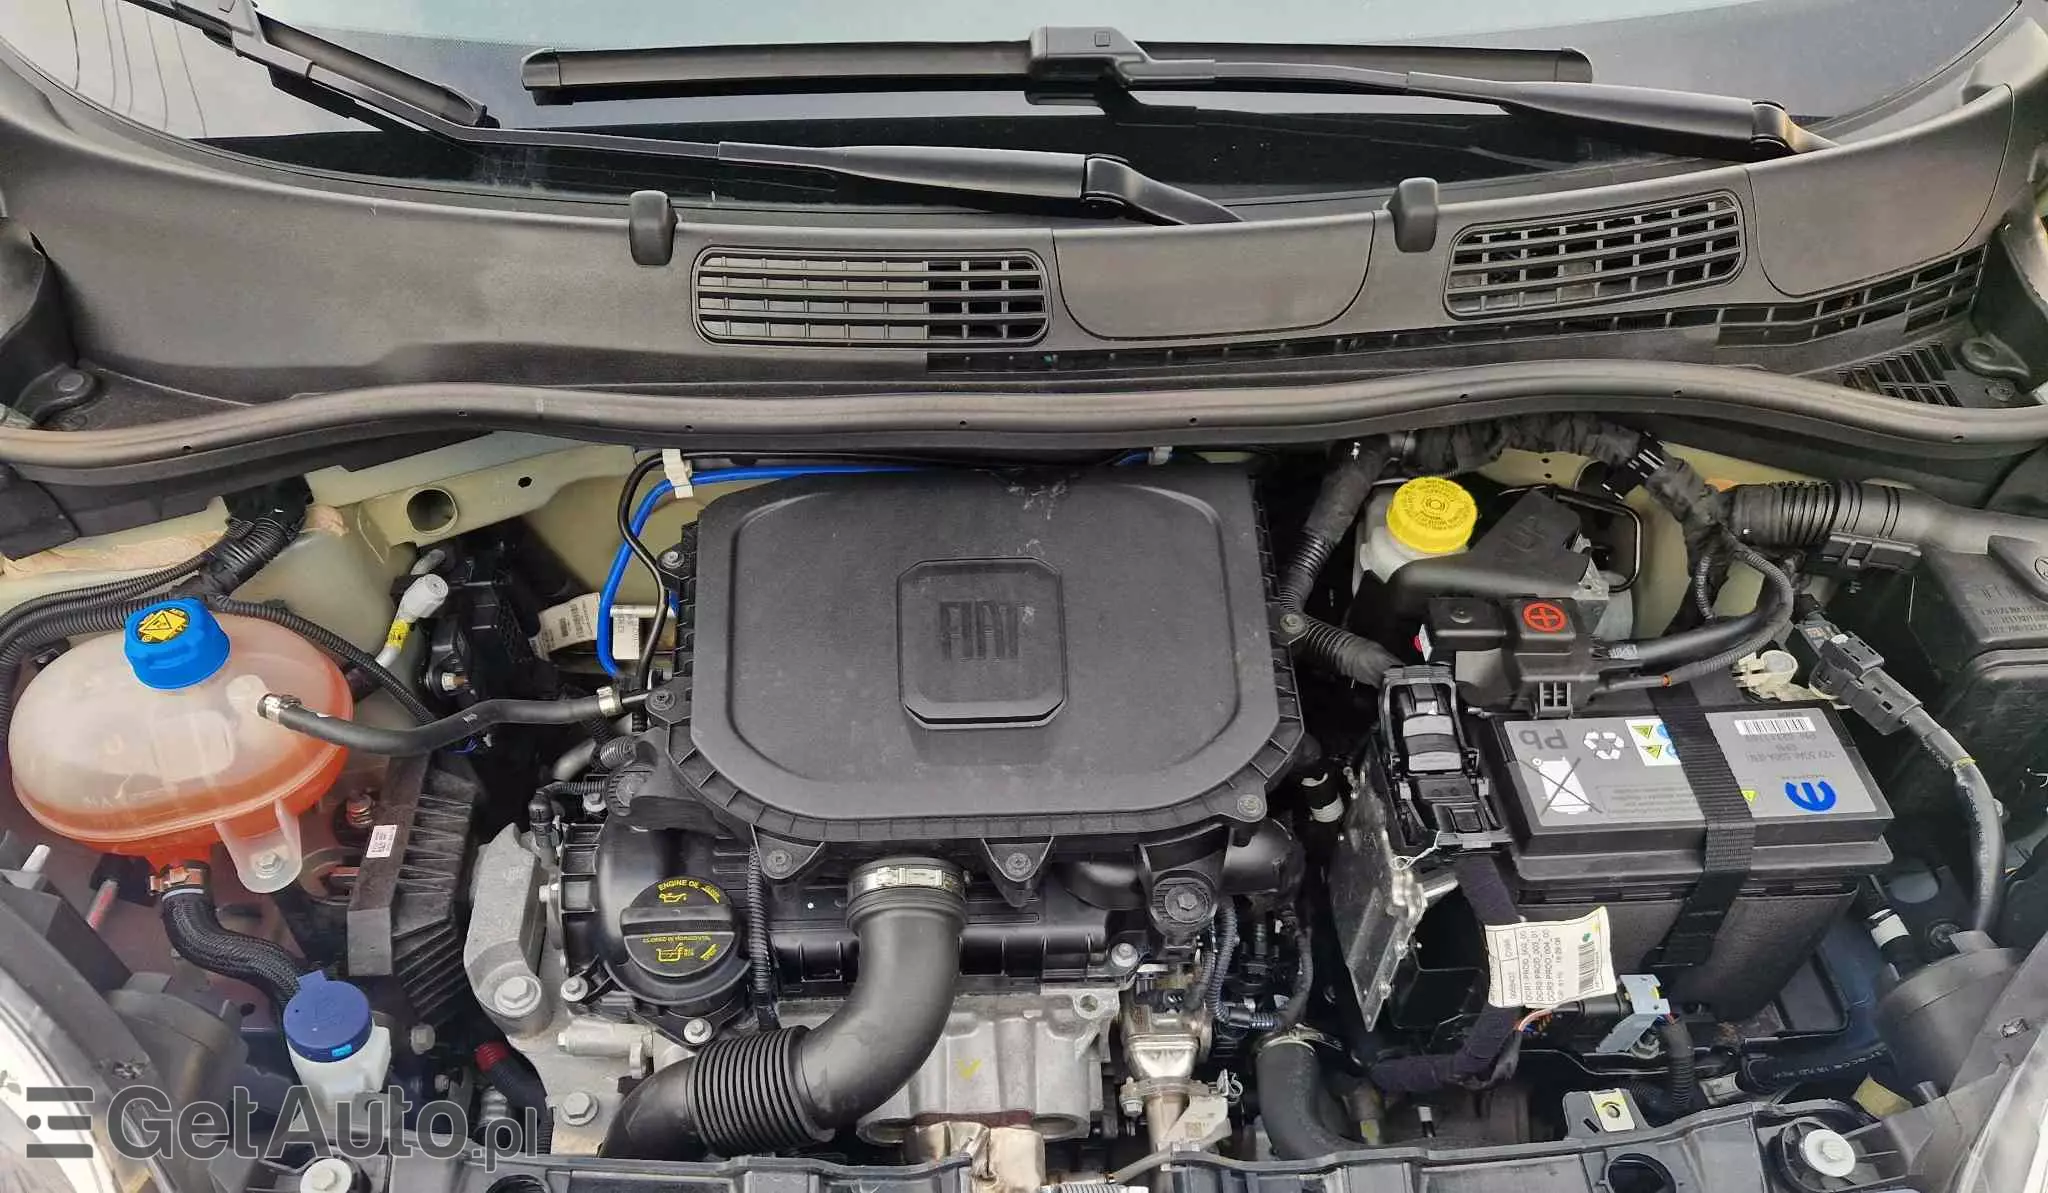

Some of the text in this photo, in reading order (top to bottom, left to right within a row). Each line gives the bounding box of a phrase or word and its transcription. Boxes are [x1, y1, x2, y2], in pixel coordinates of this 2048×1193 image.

[939, 600, 1025, 661] FIAT
[1519, 729, 1568, 751] Pb
[657, 879, 700, 891] ENGINE OIL
